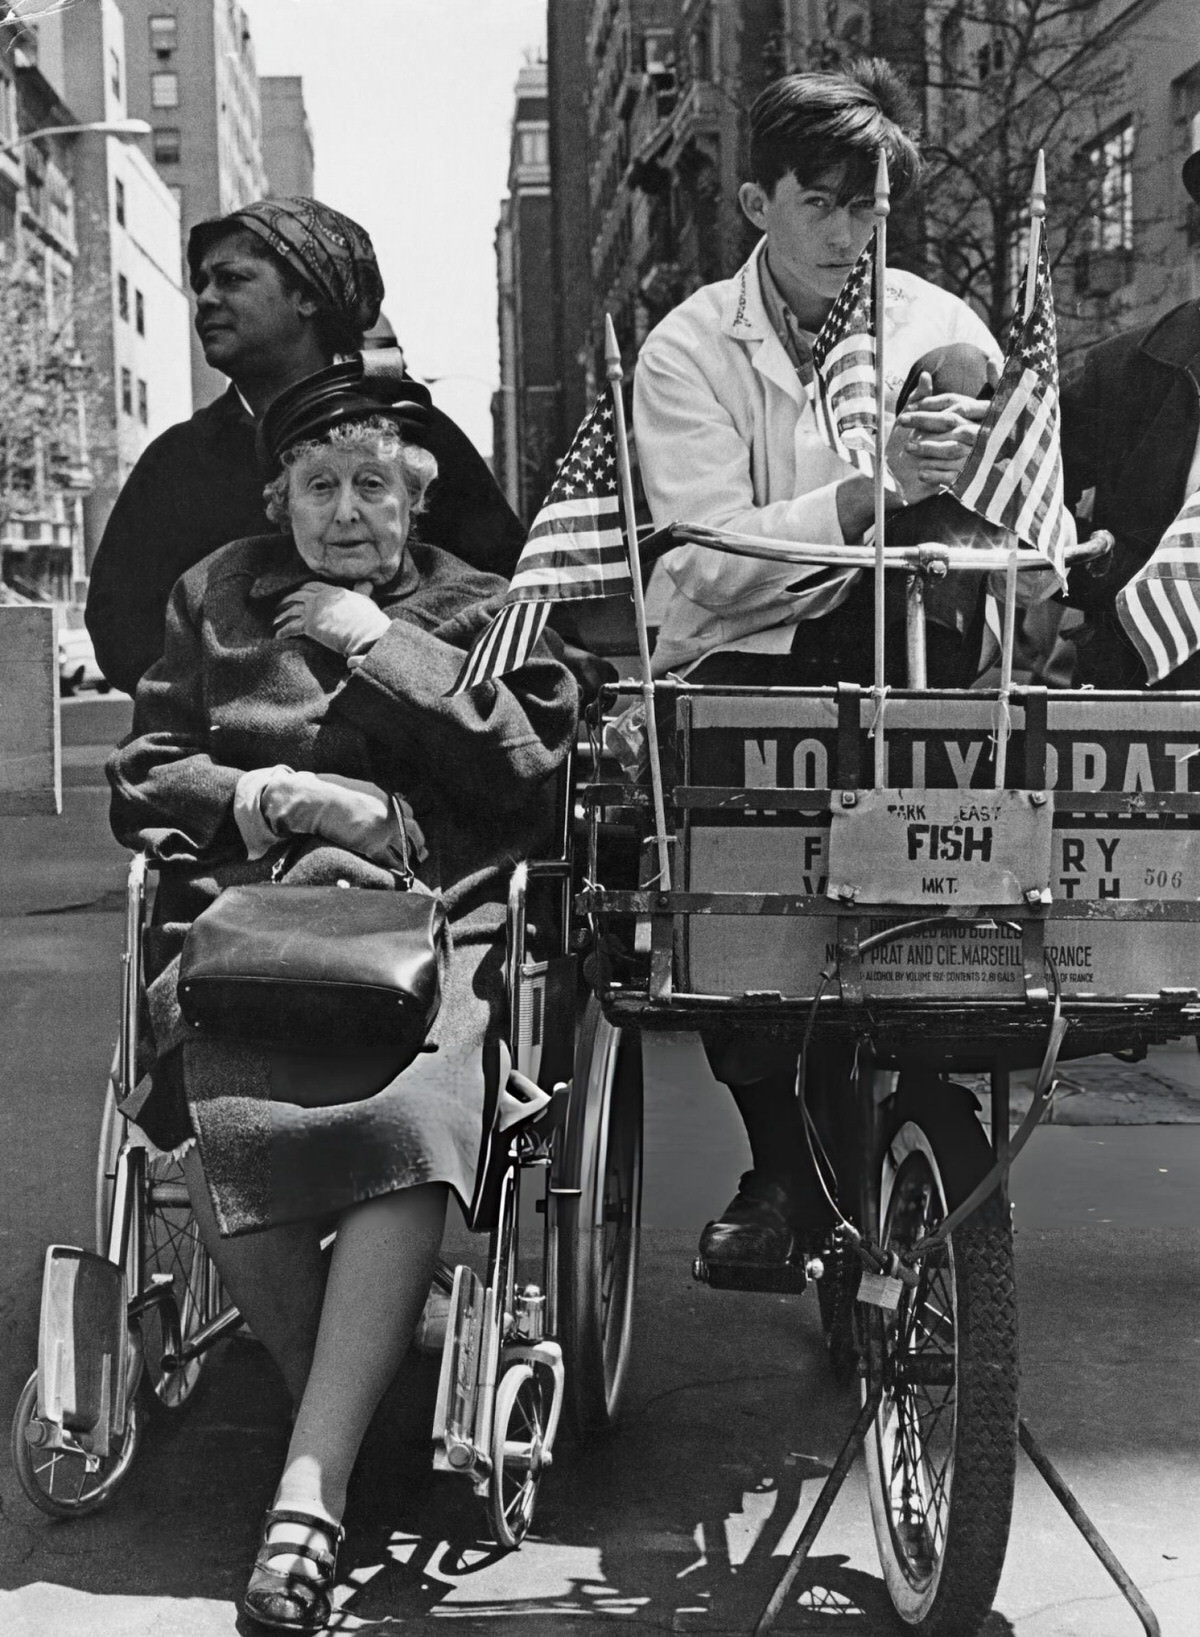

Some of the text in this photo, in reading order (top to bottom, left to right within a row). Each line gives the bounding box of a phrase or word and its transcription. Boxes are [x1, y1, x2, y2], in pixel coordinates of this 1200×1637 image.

[907, 823, 993, 862] FISH
[1144, 868, 1182, 888] 506
[871, 945, 903, 965] PRAT
[907, 945, 933, 965] AND
[1043, 946, 1092, 967] FRANCE
[865, 971, 894, 982] ALCOHOL
